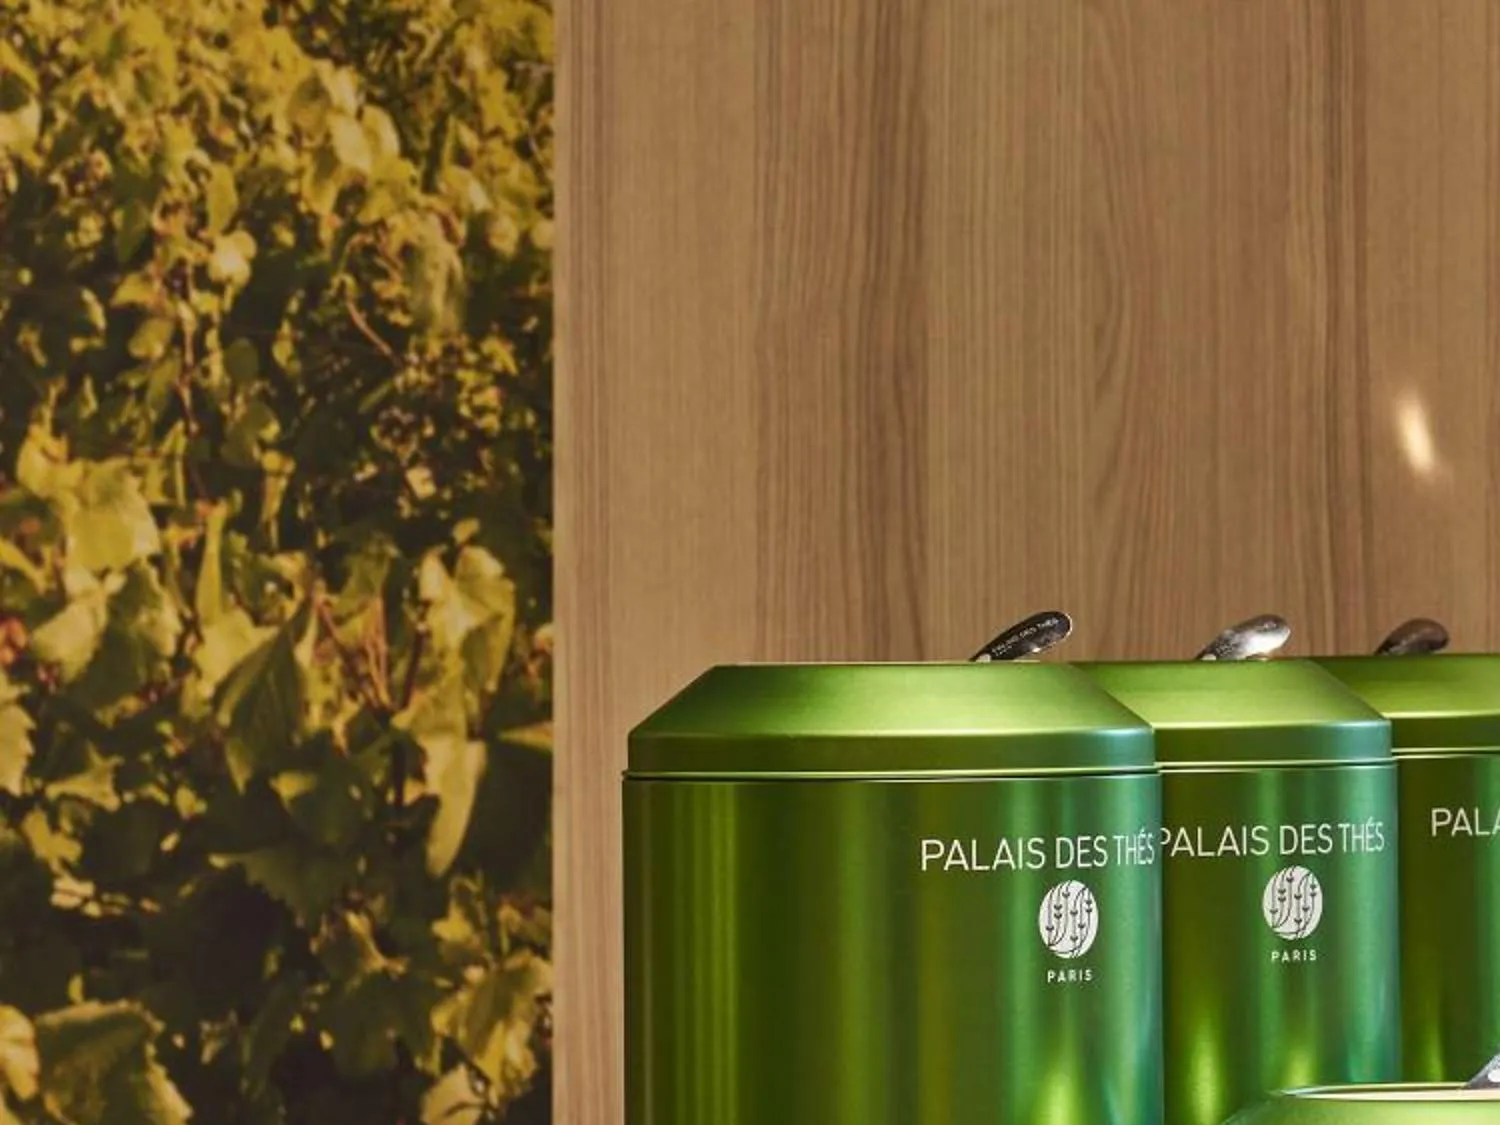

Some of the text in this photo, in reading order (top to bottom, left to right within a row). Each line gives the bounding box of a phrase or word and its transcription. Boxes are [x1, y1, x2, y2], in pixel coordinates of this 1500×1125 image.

[1279, 824, 1334, 855] DES
[1338, 816, 1385, 852] THÉS
[920, 828, 1155, 871] PALAIS DES THÉS
[1271, 949, 1318, 963] PARIS
[1047, 968, 1093, 983] PARIS
